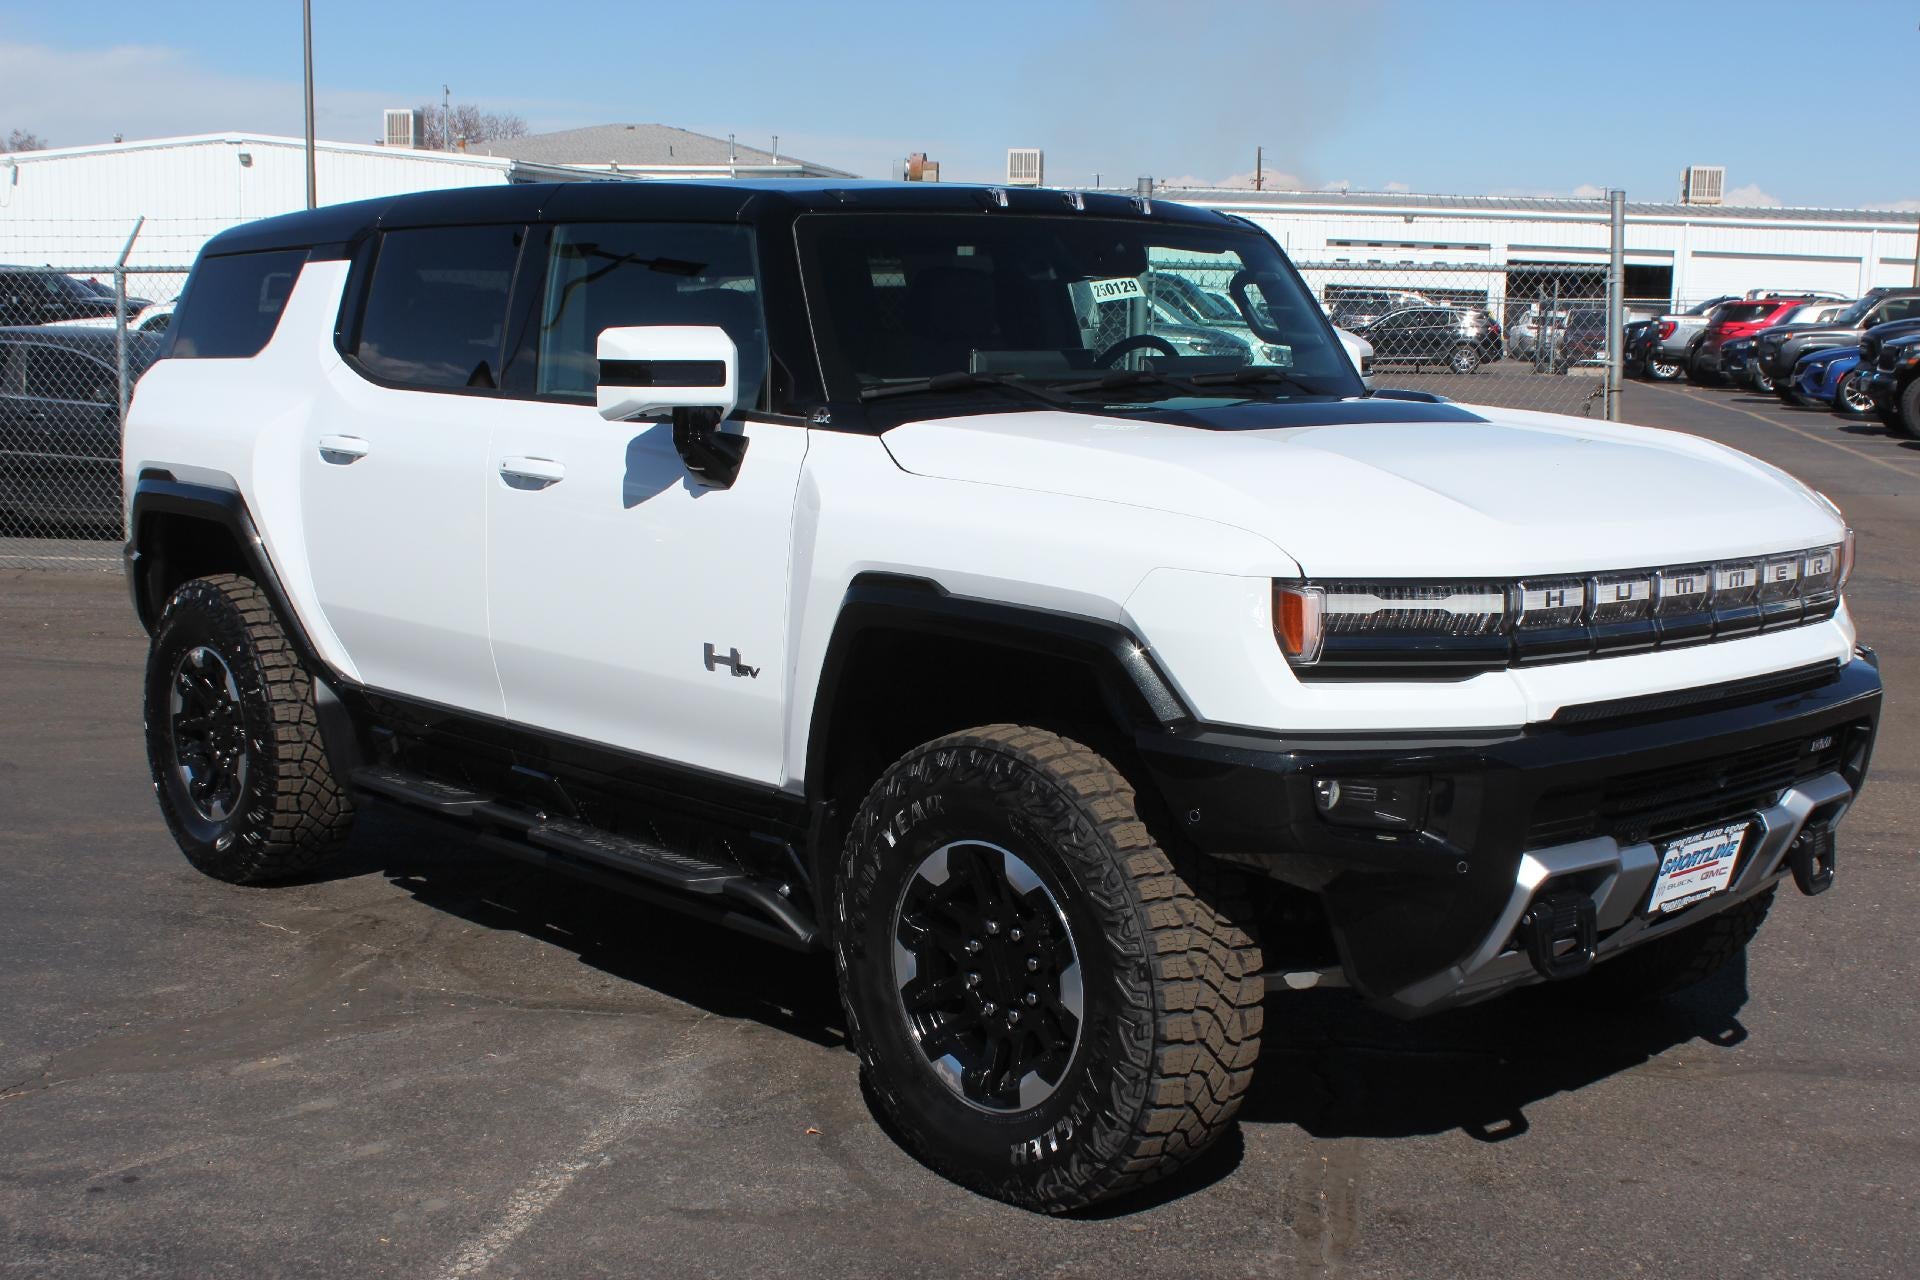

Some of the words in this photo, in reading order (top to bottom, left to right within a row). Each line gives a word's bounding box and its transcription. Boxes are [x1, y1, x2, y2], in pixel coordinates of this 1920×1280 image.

[1094, 281, 1138, 297] 250129
[1545, 559, 1823, 607] HUMMER
[1660, 840, 1740, 876] SHORTLINE
[1667, 879, 1693, 891] BUICK
[1700, 867, 1728, 881] GMC
